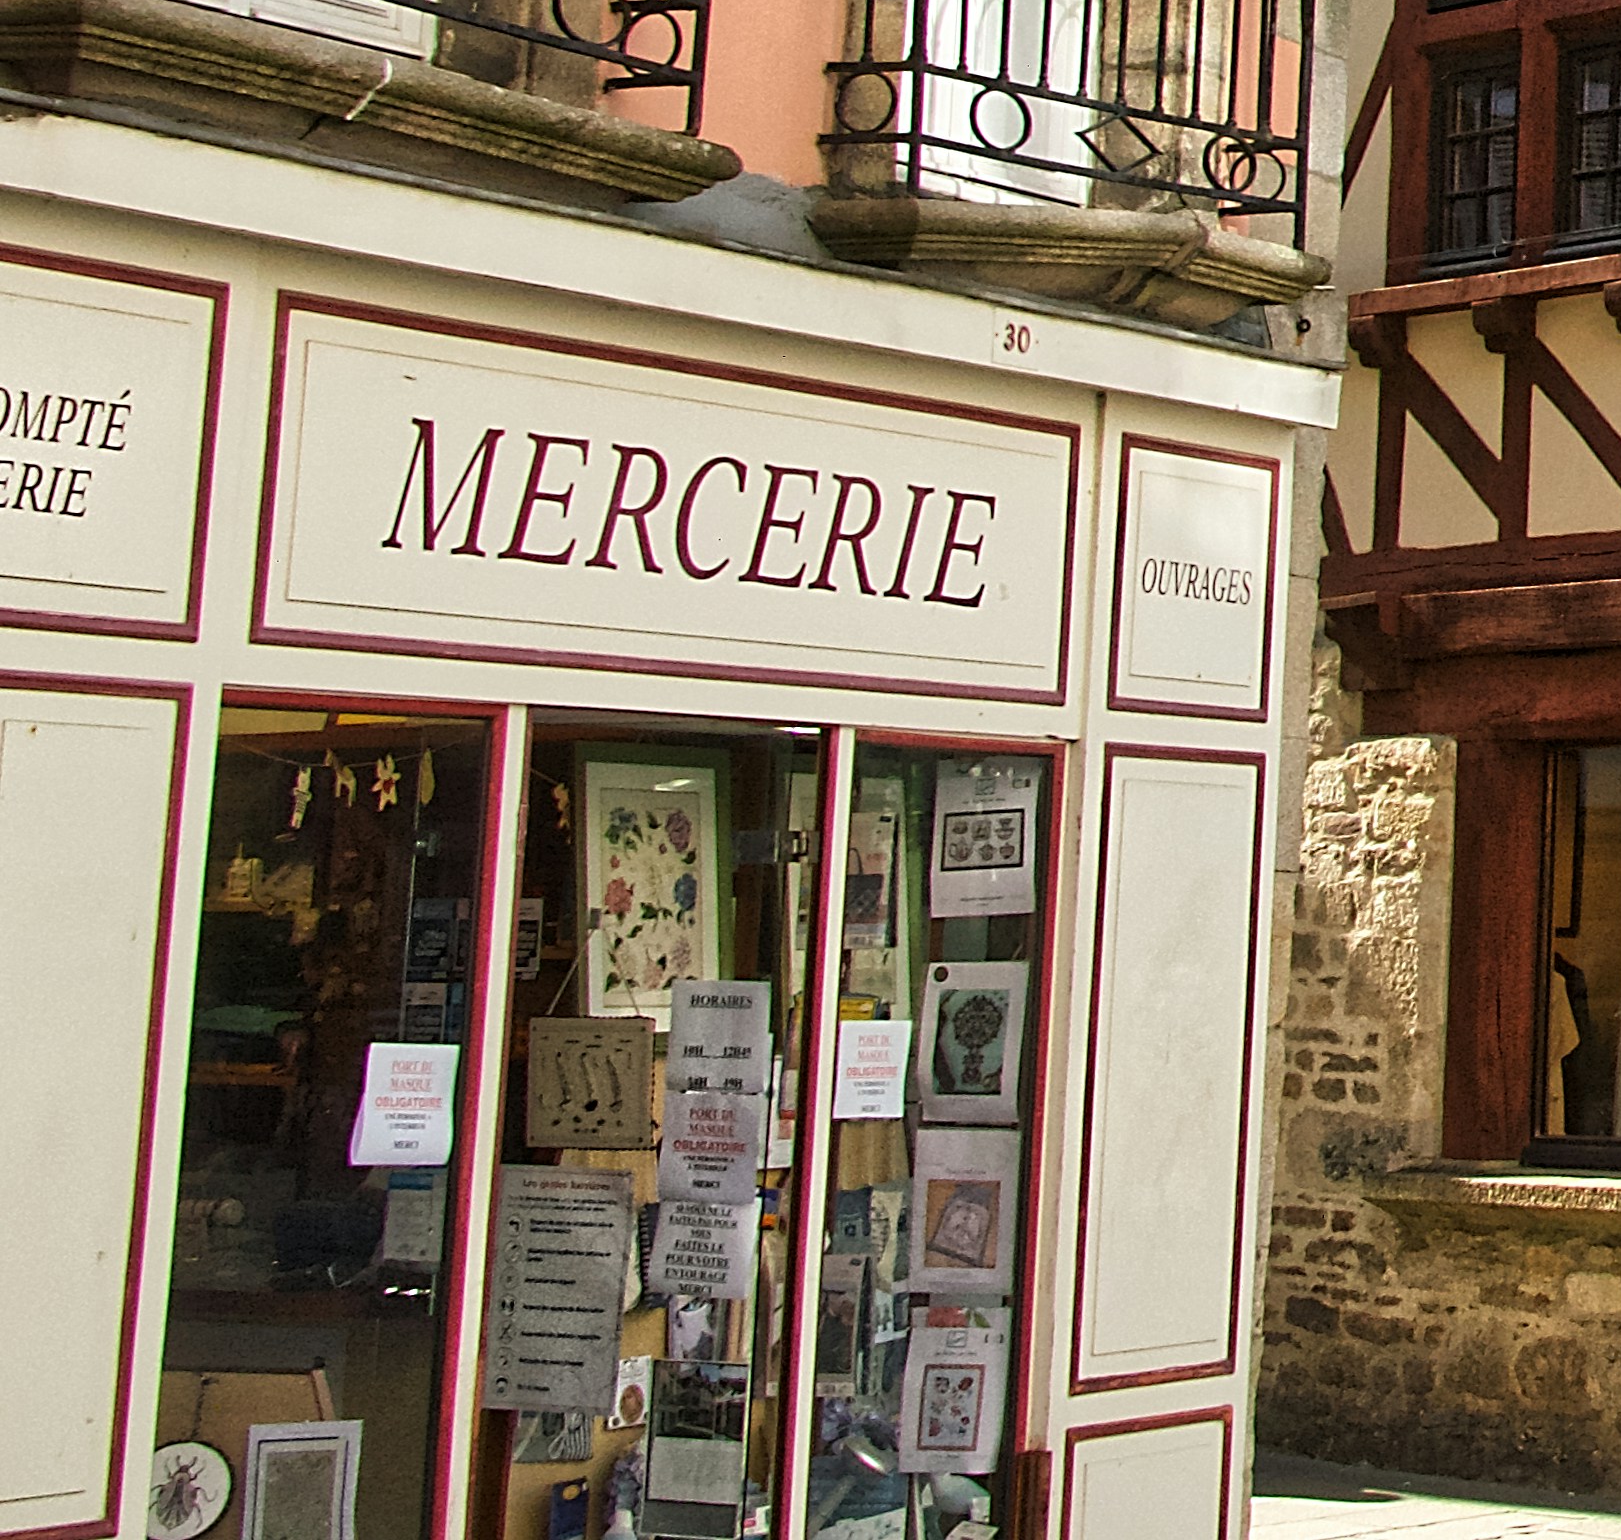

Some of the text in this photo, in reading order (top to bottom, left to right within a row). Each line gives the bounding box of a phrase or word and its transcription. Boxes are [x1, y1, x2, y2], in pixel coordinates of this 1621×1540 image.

[1003, 323, 1031, 353] 30
[381, 417, 996, 608] MERCERIE
[1142, 558, 1252, 605] OUVRAGES
[690, 994, 752, 1009] HORAIRES
[375, 1096, 443, 1109] OBLIGATOIRE
[673, 1140, 747, 1154] OBLIGATOIRE
